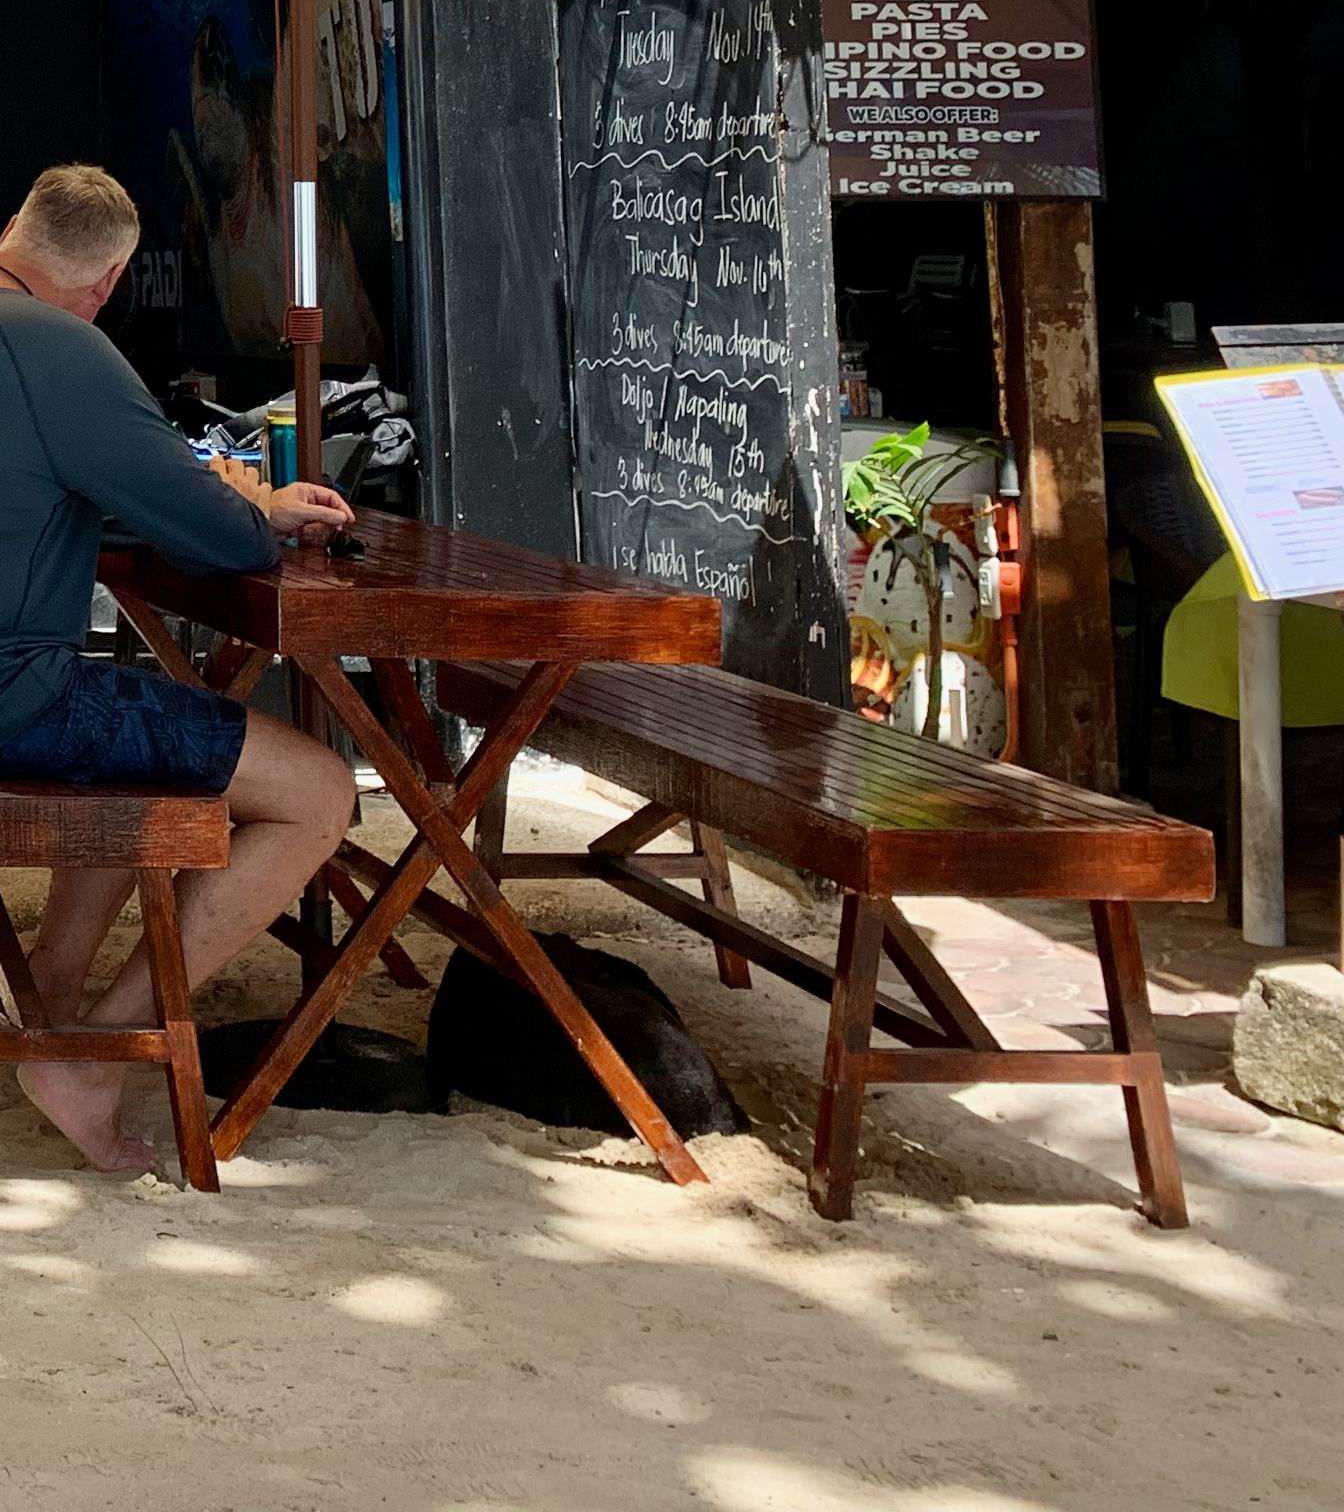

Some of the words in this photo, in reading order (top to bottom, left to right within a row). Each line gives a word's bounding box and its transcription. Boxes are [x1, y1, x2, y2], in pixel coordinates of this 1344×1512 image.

[851, 3, 988, 20] PASTA
[872, 22, 968, 40] PIES
[616, 10, 674, 85] Tuesday
[825, 42, 946, 59] IPINO
[957, 42, 1086, 59] FOOD
[825, 61, 1021, 79] SIZZLING
[828, 81, 904, 98] HAI
[916, 81, 1044, 99] FOOD
[609, 97, 644, 145] dives
[847, 107, 880, 123] WE
[880, 106, 931, 123] ALSO
[932, 106, 1000, 123] OFFER:
[957, 127, 1040, 142] Beer
[870, 144, 980, 160] Shake
[880, 161, 972, 177] Juice
[839, 178, 891, 194] Ice
[898, 178, 1014, 194] Cream
[713, 171, 780, 231] Island
[625, 231, 699, 307] Thursday
[717, 246, 748, 287] Nov.
[674, 384, 747, 447] Napaling
[644, 419, 712, 482] Wednesday
[728, 438, 765, 478] 15th
[645, 529, 688, 582] habla
